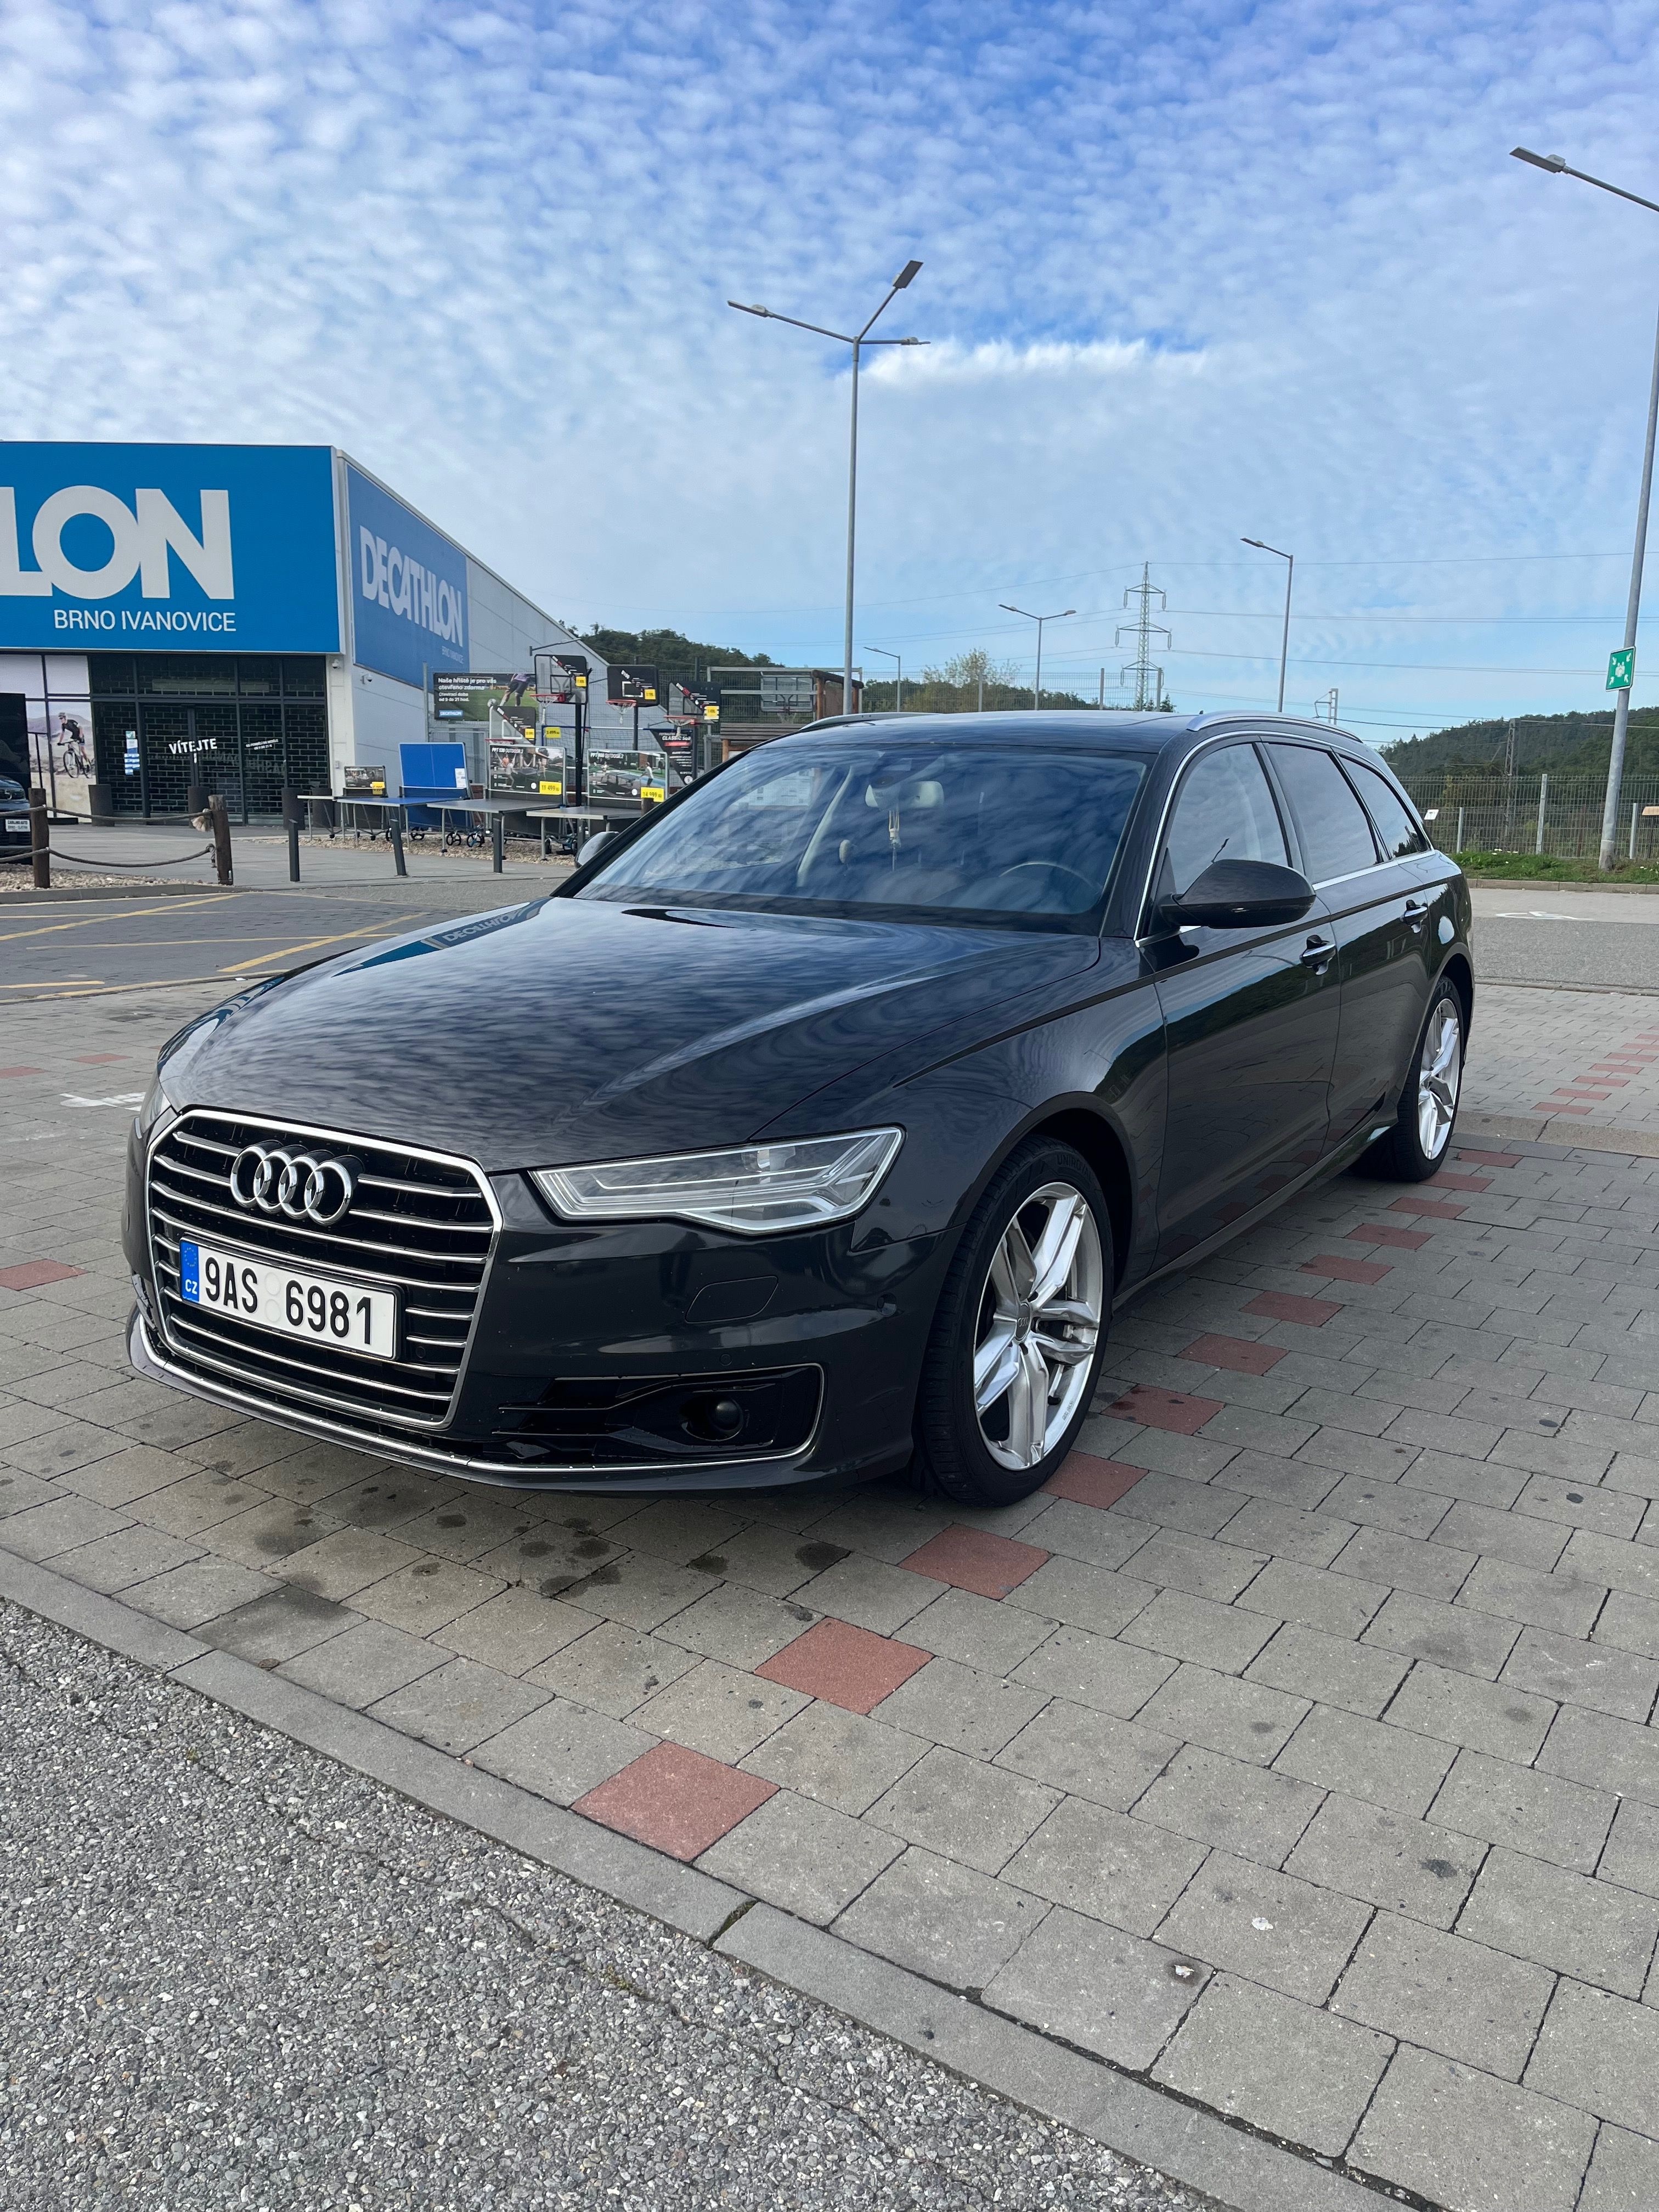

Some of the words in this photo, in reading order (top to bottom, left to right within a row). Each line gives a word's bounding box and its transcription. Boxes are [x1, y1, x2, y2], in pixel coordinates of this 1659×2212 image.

[0, 485, 234, 599] LON
[360, 525, 463, 647] DECATHLON
[54, 610, 115, 630] BRNO
[122, 611, 236, 631] IVANOVICE
[168, 738, 218, 754] VÍTEJTE
[1057, 1154, 1092, 1181] UNIROYAL
[185, 1279, 198, 1295] CZ
[205, 1256, 258, 1313] 9AS
[285, 1279, 372, 1345] 6981
